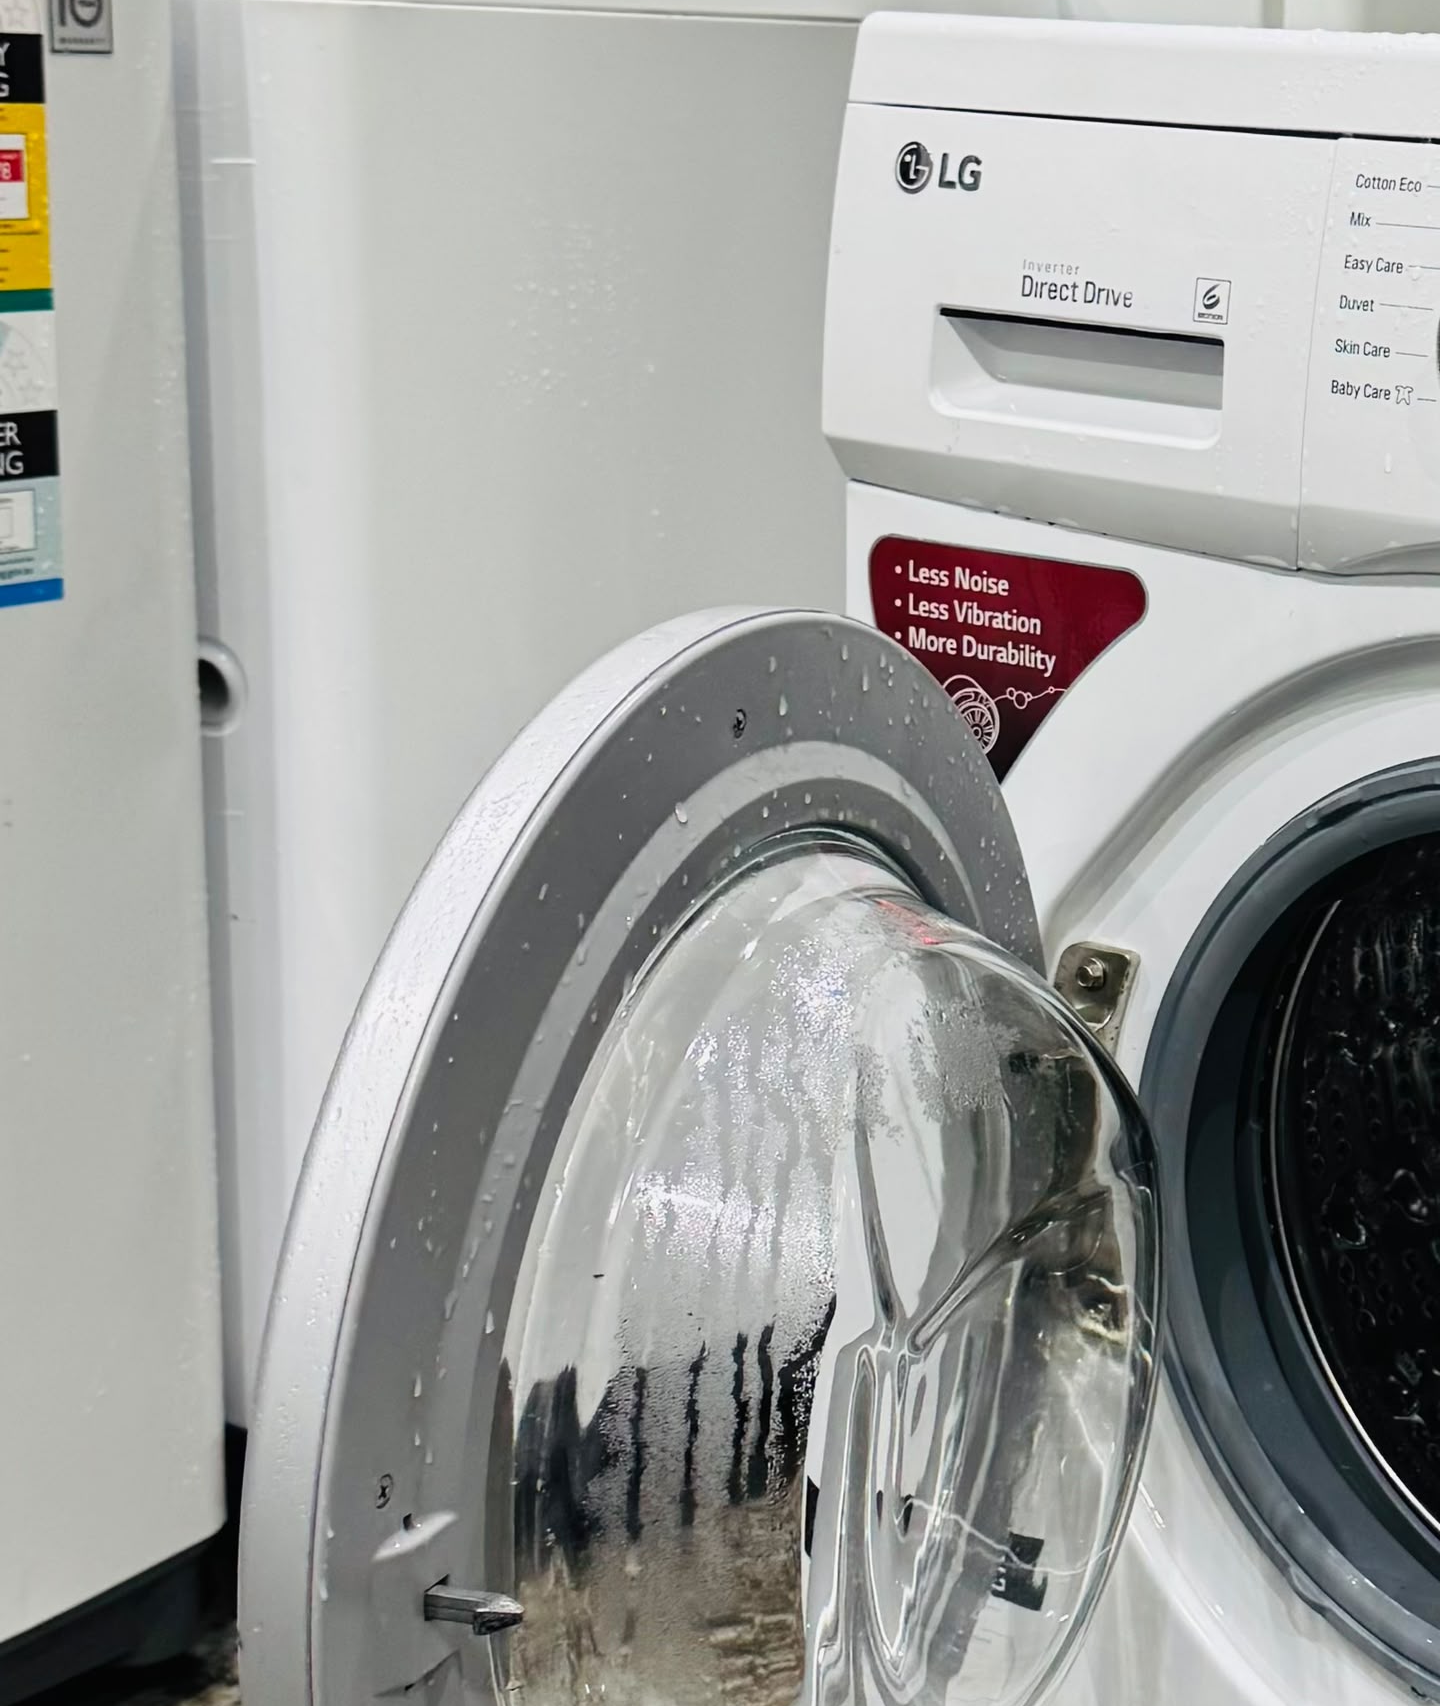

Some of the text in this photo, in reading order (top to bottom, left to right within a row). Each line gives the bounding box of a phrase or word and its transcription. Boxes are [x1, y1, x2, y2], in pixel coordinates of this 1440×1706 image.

[938, 152, 982, 192] LG
[1355, 174, 1422, 192] Cotton Eco
[1350, 211, 1371, 227] Mix
[1022, 259, 1080, 275] Inverter
[1344, 254, 1404, 274] Easy Care
[1021, 275, 1133, 308] Direct Drive
[1339, 295, 1374, 312] Duvet
[1335, 338, 1390, 357] Skin Care
[1331, 380, 1391, 400] Baby Care
[908, 559, 1010, 596] Less Noise
[908, 593, 1042, 635] Less Vibration
[908, 626, 1056, 678] More Durability
